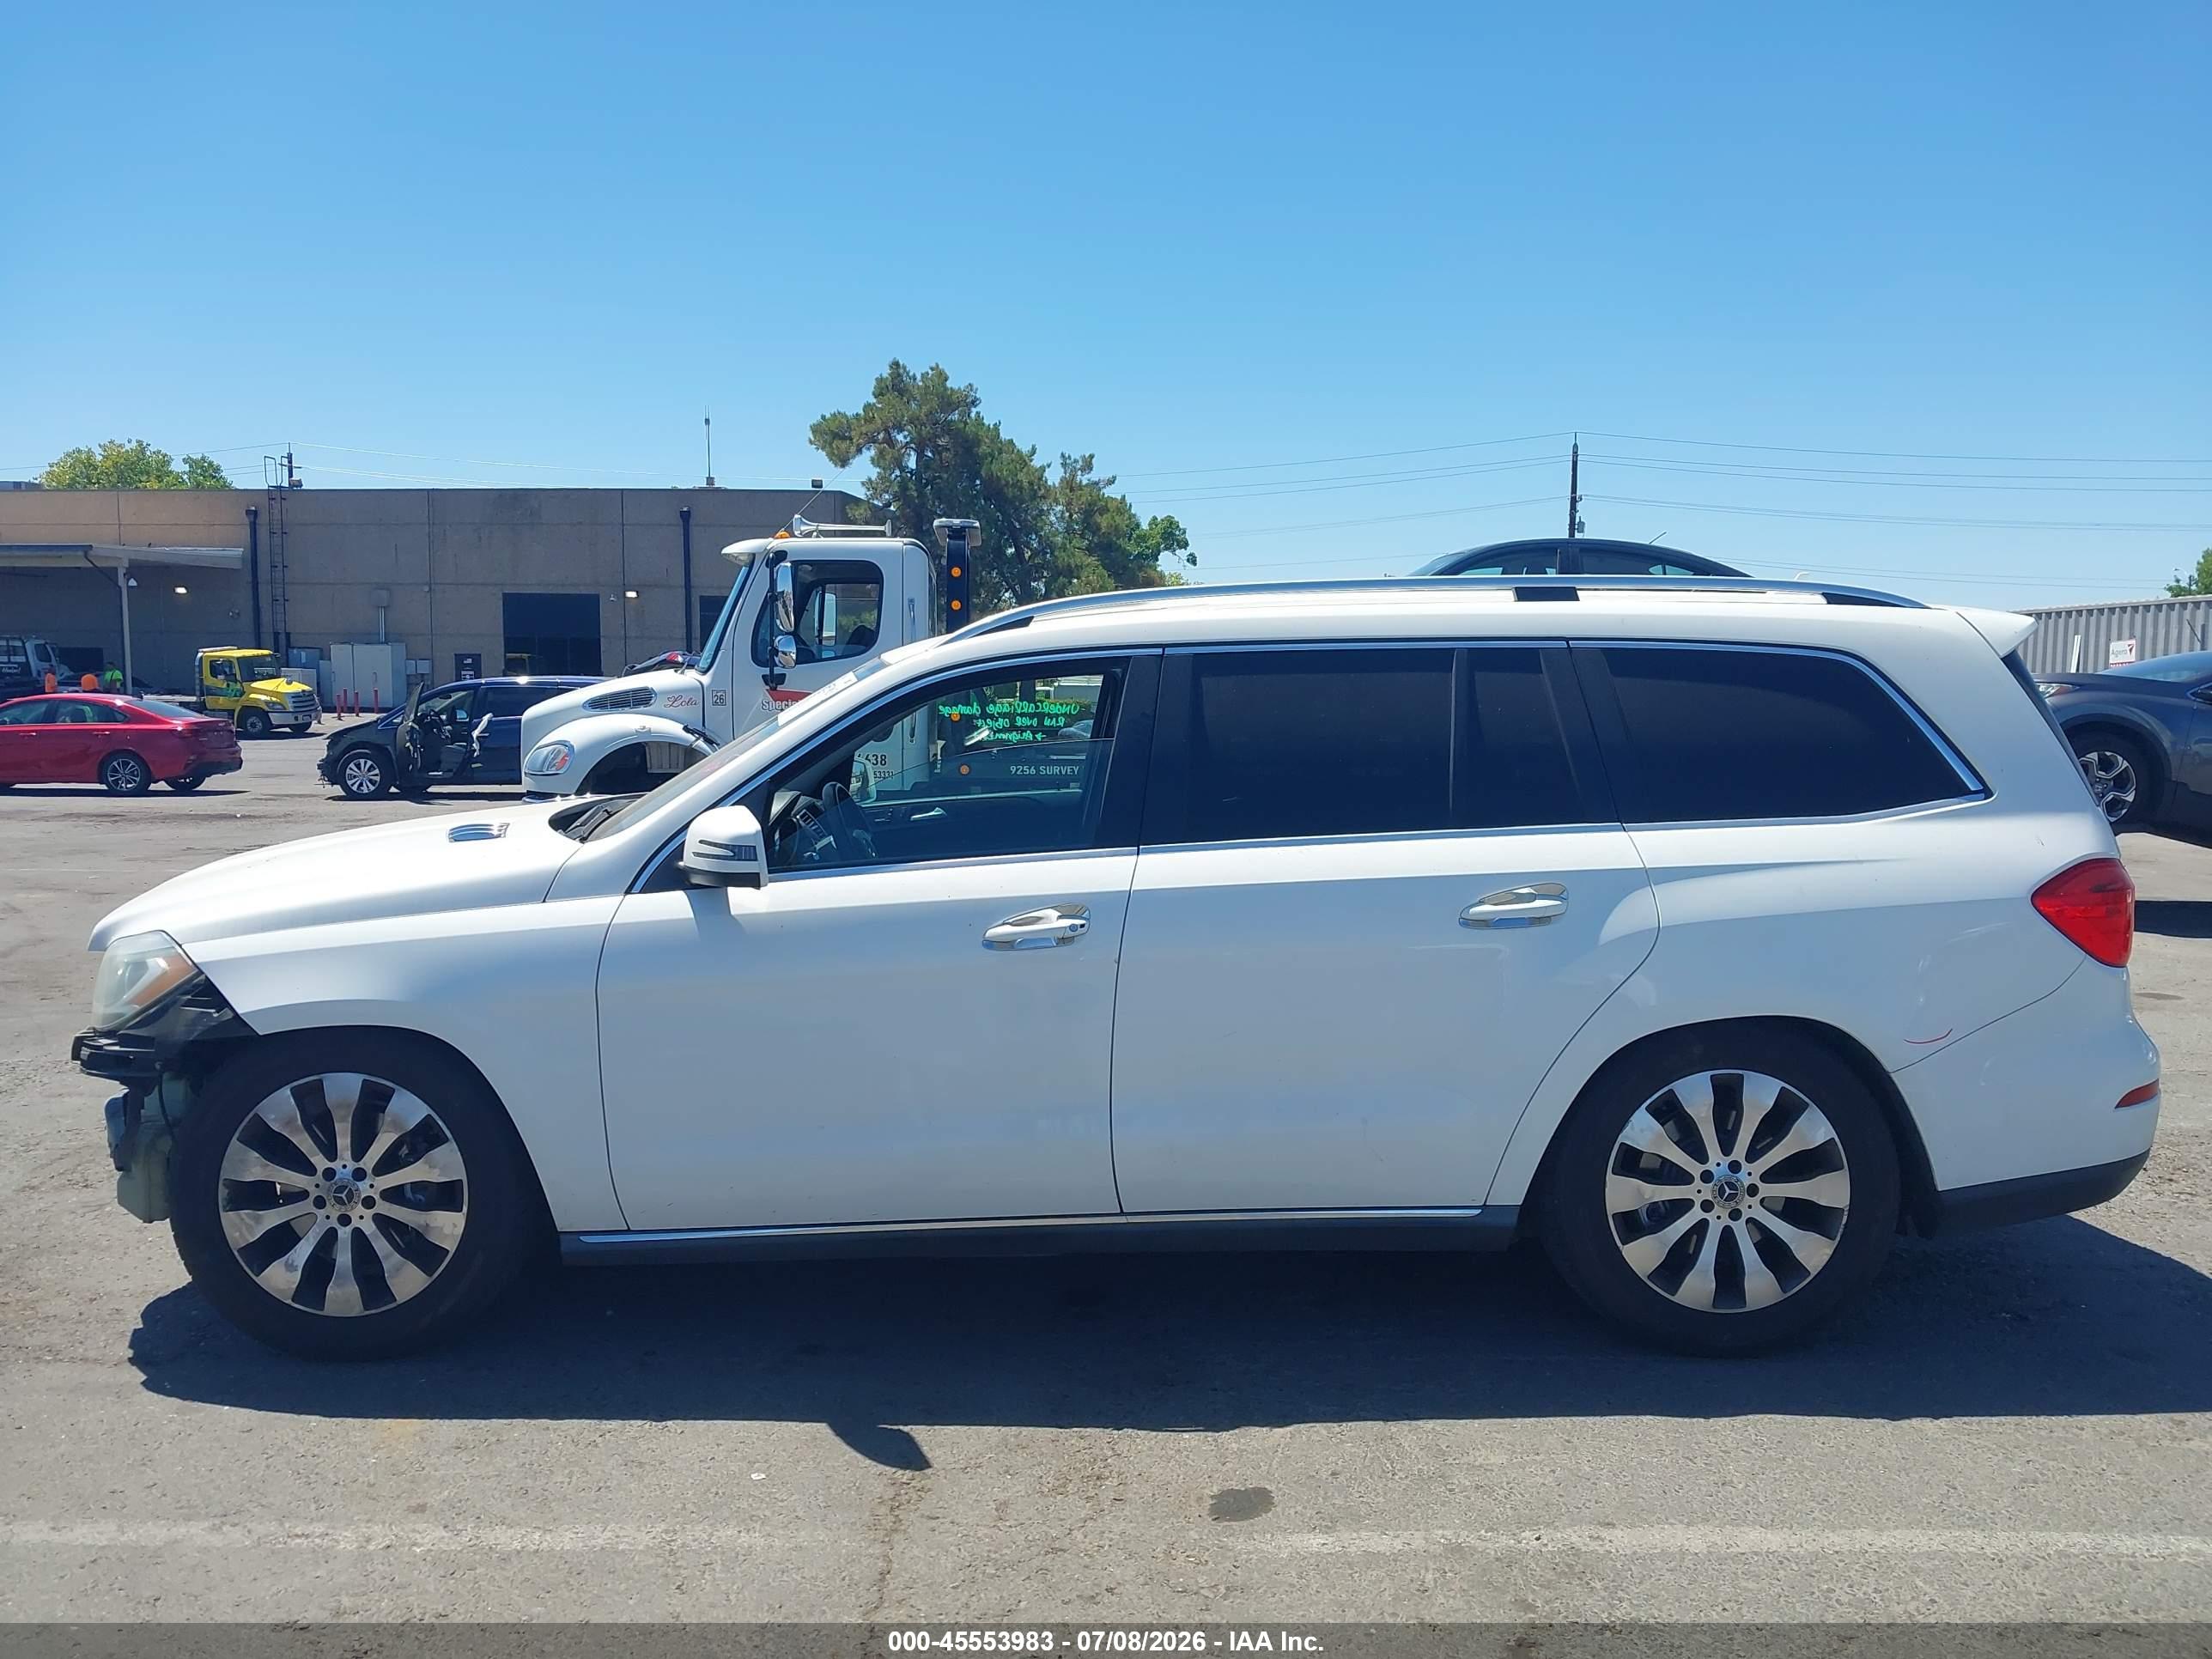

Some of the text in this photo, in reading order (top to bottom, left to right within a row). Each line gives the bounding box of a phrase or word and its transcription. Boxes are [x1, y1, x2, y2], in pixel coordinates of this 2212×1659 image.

[664, 694, 700, 708] Lola
[714, 694, 725, 704] 26
[1010, 765, 1079, 775] 9256 SURVEY
